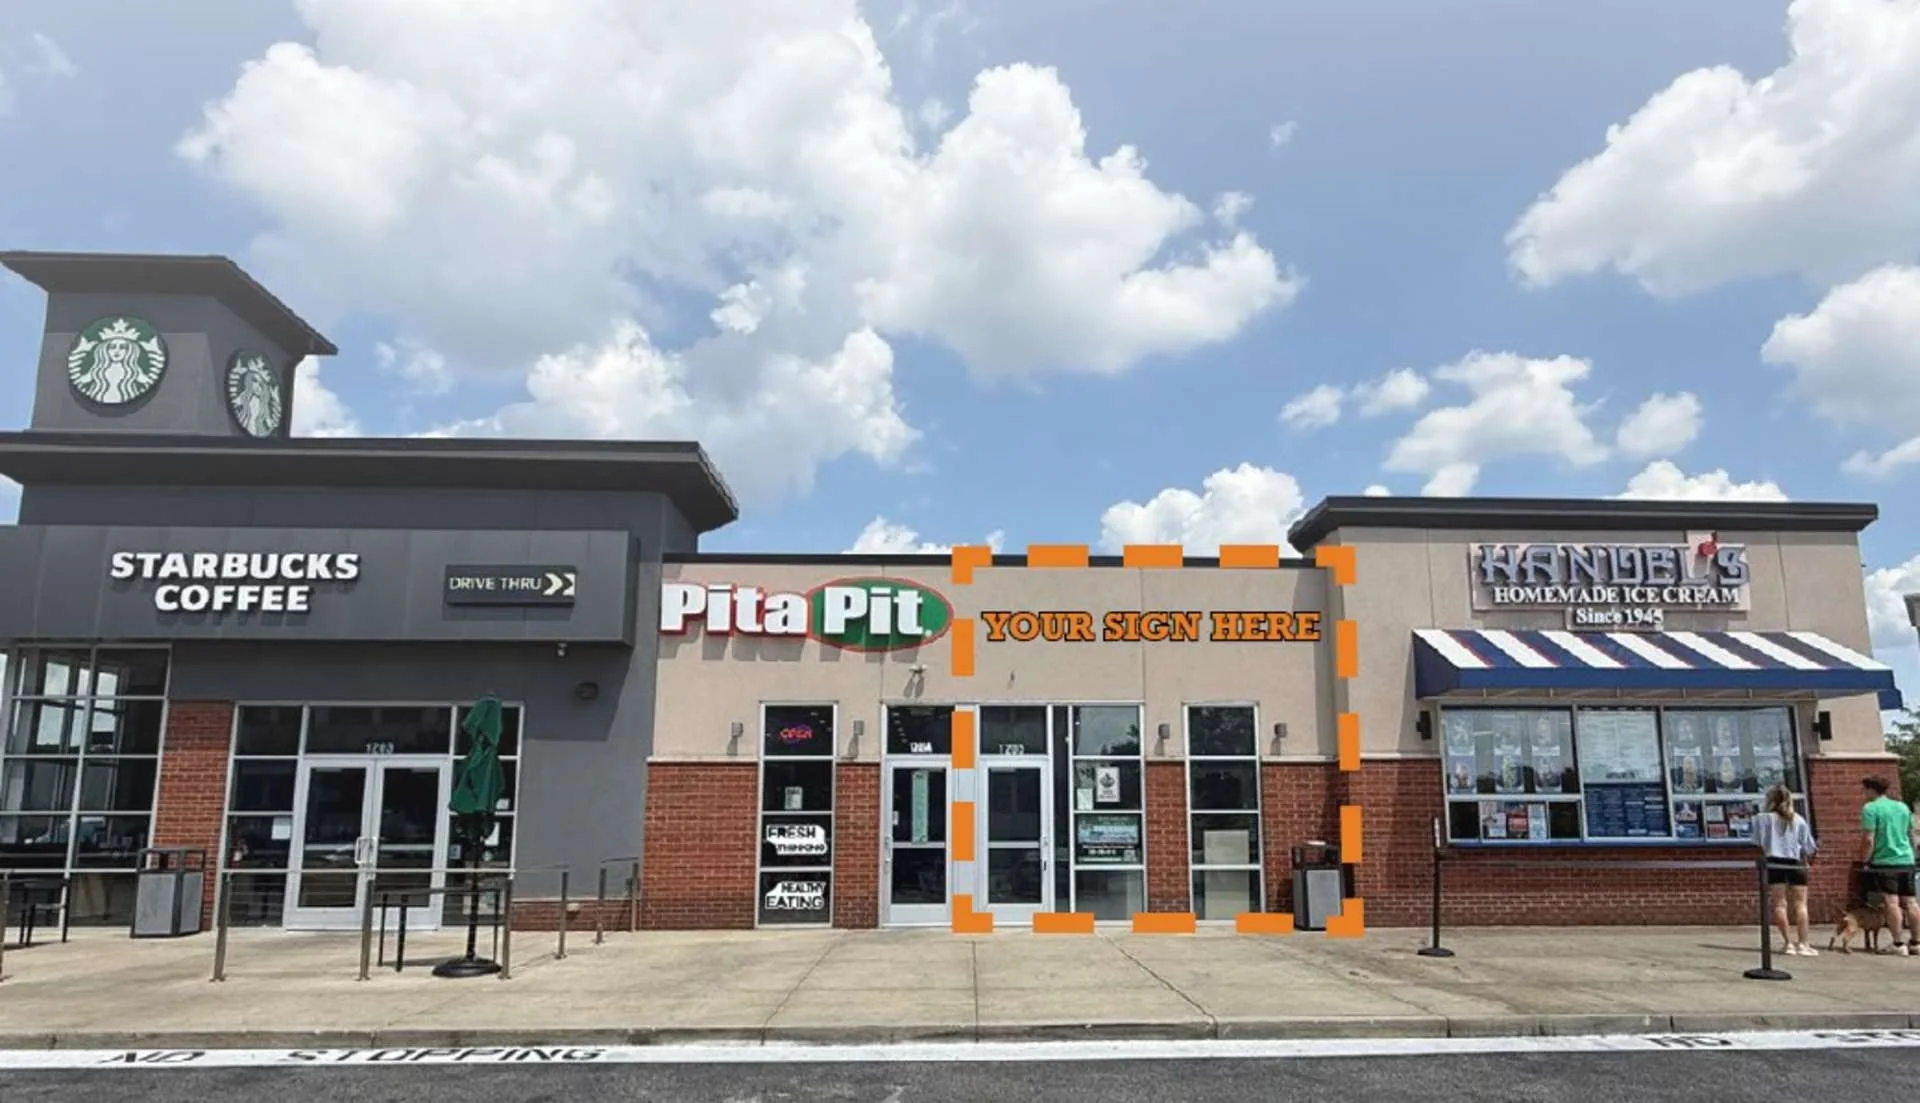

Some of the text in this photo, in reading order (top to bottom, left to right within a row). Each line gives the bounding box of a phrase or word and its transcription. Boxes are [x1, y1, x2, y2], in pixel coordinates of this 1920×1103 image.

[110, 552, 359, 580] STARBUCKS
[1479, 544, 1749, 586] HANDEL'S
[450, 576, 542, 591] DRIVE THRU
[154, 584, 310, 612] COFFEE
[1494, 585, 1740, 605] HOMEMADE ICE CREAM
[658, 583, 924, 636] Pita Pit
[1575, 607, 1665, 625] Since 1945
[766, 825, 817, 839] FRESH
[765, 895, 824, 909] EATING
[280, 1048, 606, 1062] STOPPING
